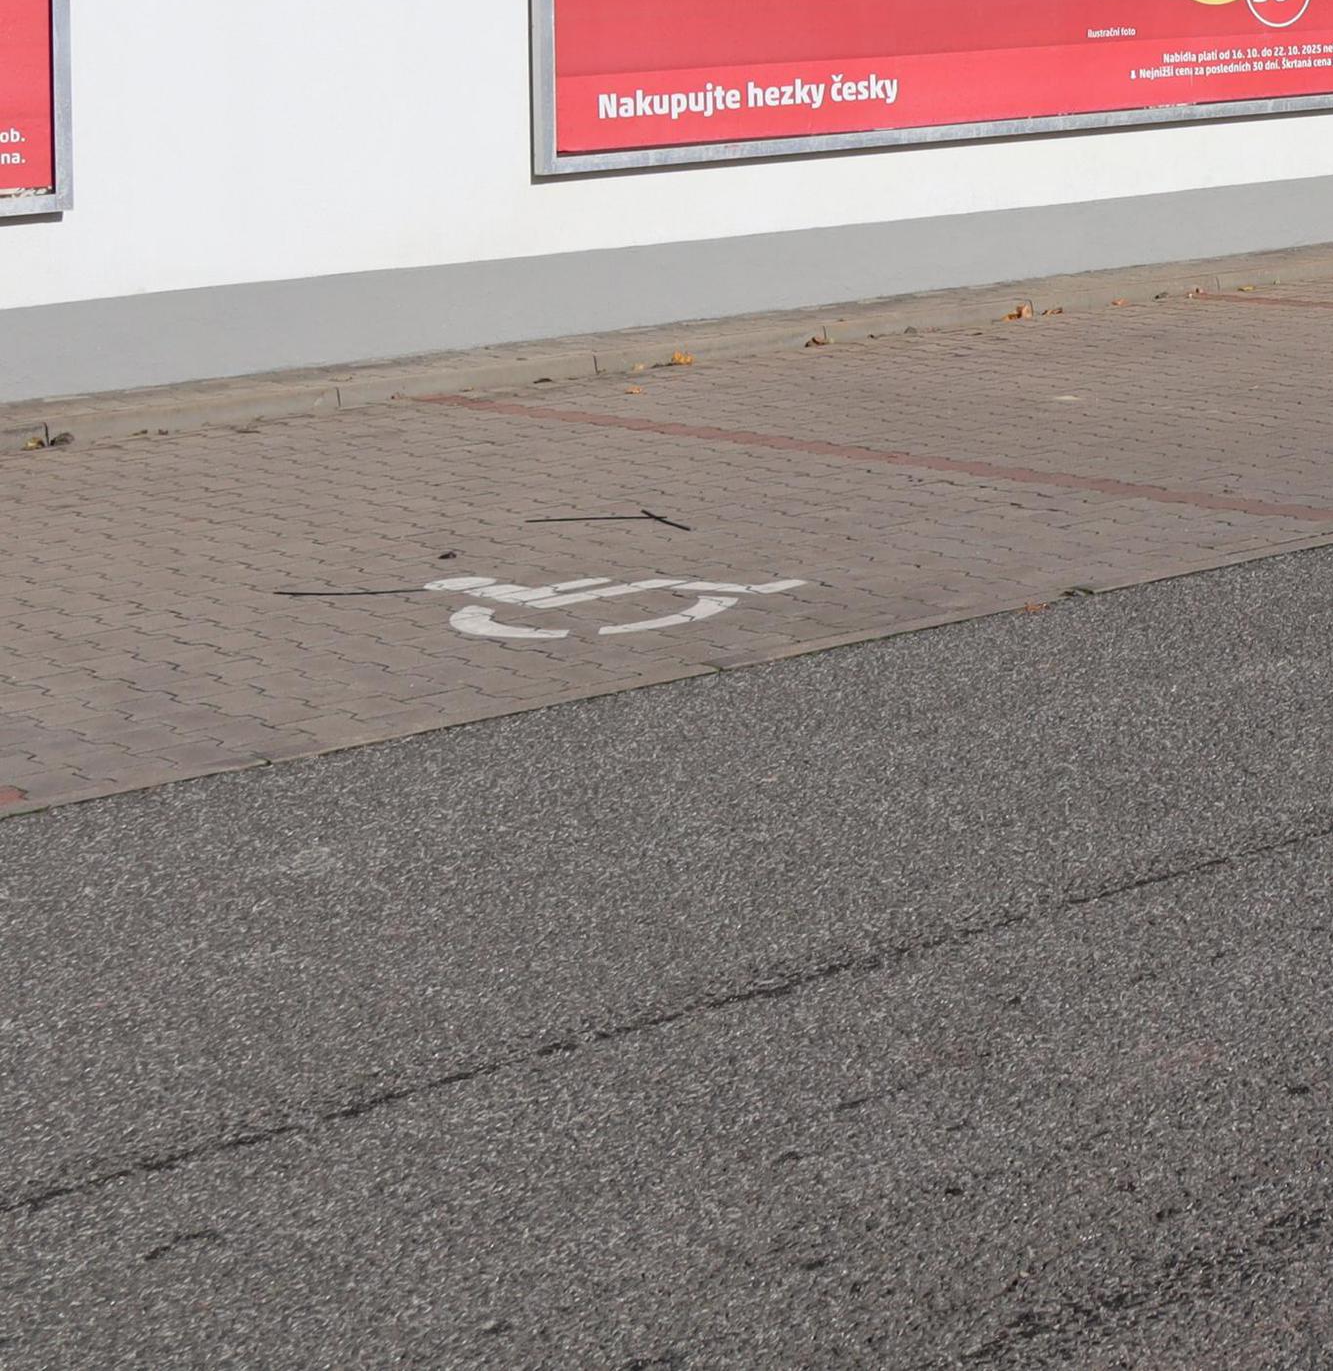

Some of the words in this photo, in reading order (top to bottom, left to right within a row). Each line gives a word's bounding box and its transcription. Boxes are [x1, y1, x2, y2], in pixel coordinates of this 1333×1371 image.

[1121, 27, 1136, 37] foto
[1219, 49, 1230, 60] od
[1232, 48, 1245, 59] 16.
[1247, 48, 1260, 58] 10.
[1261, 46, 1272, 57] do
[1273, 46, 1286, 56] 22.
[1288, 45, 1300, 55] 10.
[1302, 44, 1321, 55] 2025
[1194, 65, 1204, 75] za
[1205, 62, 1250, 77] posledních
[1265, 58, 1280, 70] dní.
[1281, 56, 1312, 69] Škrtaná
[1313, 58, 1331, 67] cena
[598, 83, 741, 119] Nakupujte
[747, 78, 824, 109] hezky
[831, 74, 898, 103] česky
